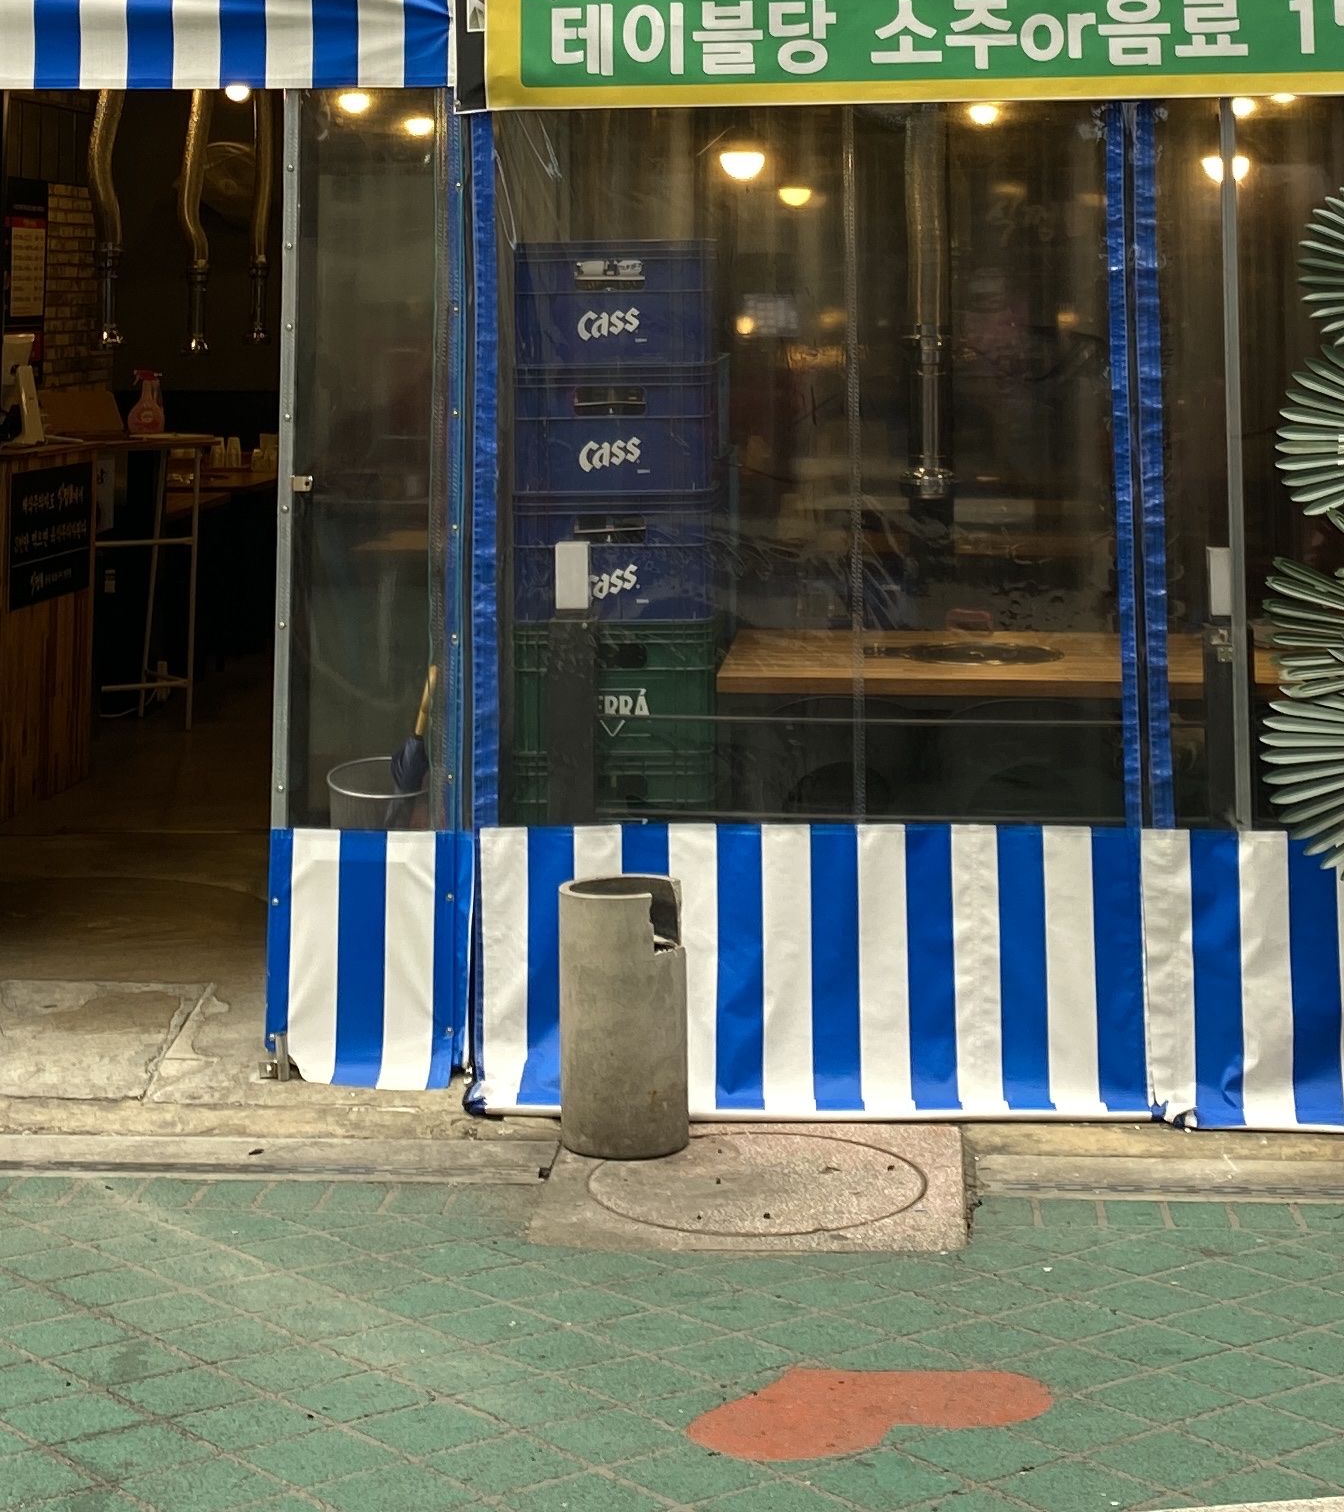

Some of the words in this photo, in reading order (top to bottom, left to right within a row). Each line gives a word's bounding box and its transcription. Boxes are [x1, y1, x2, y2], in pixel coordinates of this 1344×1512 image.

[549, 0, 836, 78] 테이블당
[577, 306, 641, 342] Cass
[578, 436, 642, 474] Cass
